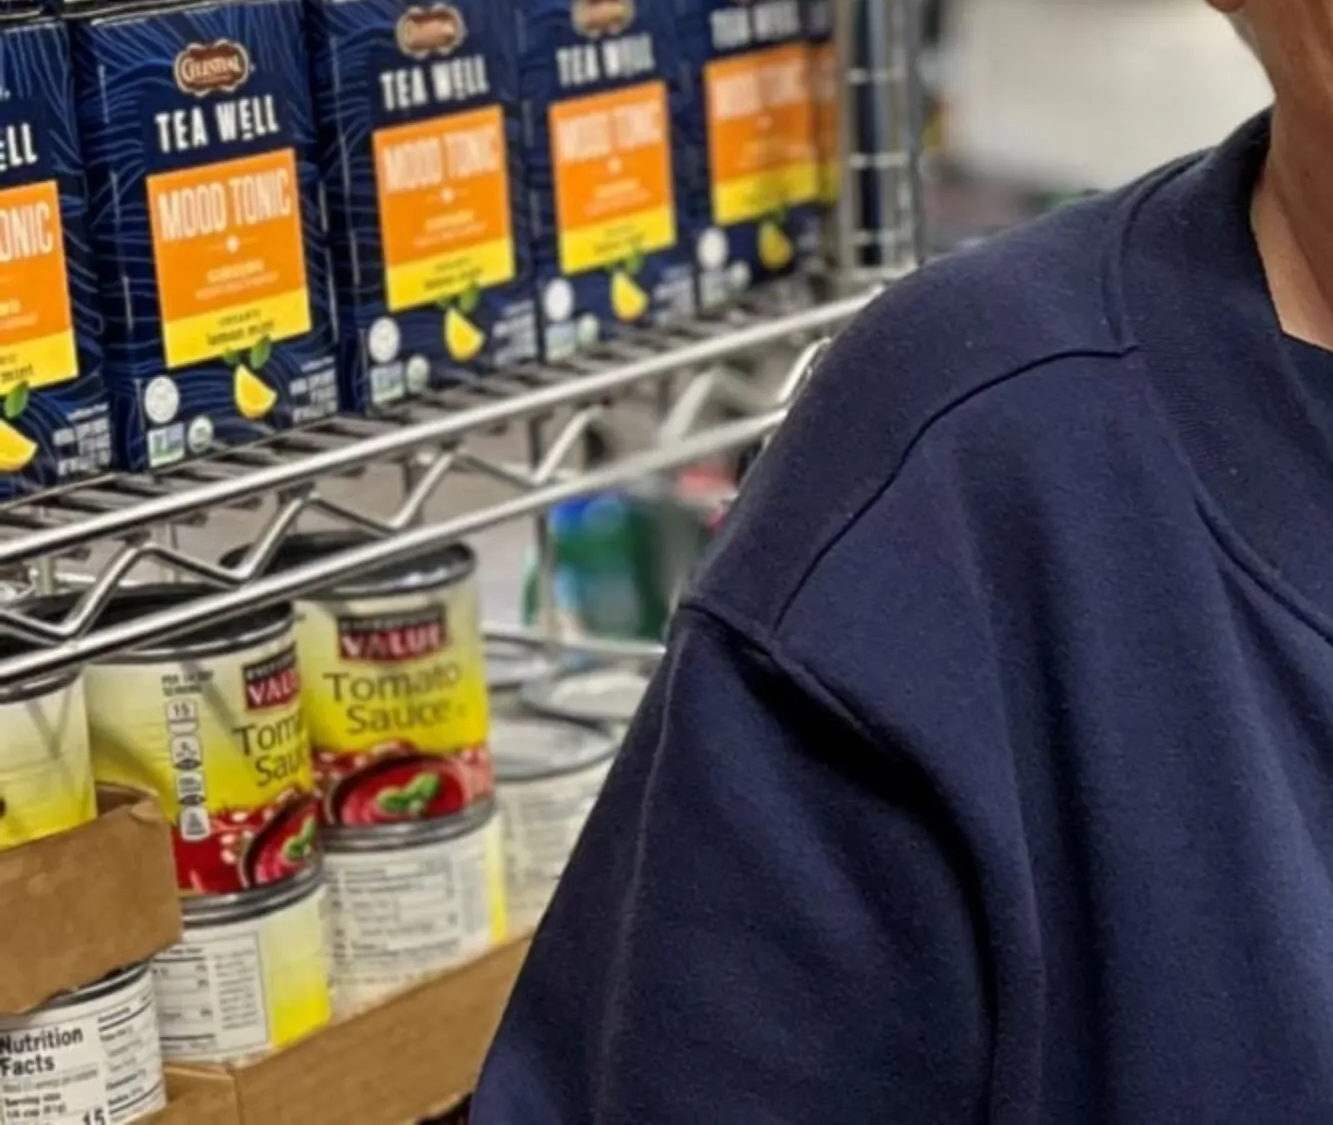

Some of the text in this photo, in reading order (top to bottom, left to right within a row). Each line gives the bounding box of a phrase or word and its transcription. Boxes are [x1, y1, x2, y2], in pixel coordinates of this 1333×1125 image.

[380, 53, 490, 111] TEA WELL
[155, 94, 280, 153] TEA WELL
[0, 122, 38, 172] LL
[158, 168, 292, 242] MOOD TONIC
[0, 201, 54, 263] ONIC
[341, 621, 440, 657] VALUE
[247, 668, 299, 706] VAL
[322, 662, 462, 702] Tomato
[231, 712, 301, 756] Tom
[345, 699, 450, 735] Sauce
[255, 752, 302, 787] Sau
[0, 1026, 84, 1055] Nutrition
[0, 1053, 56, 1076] Facts
